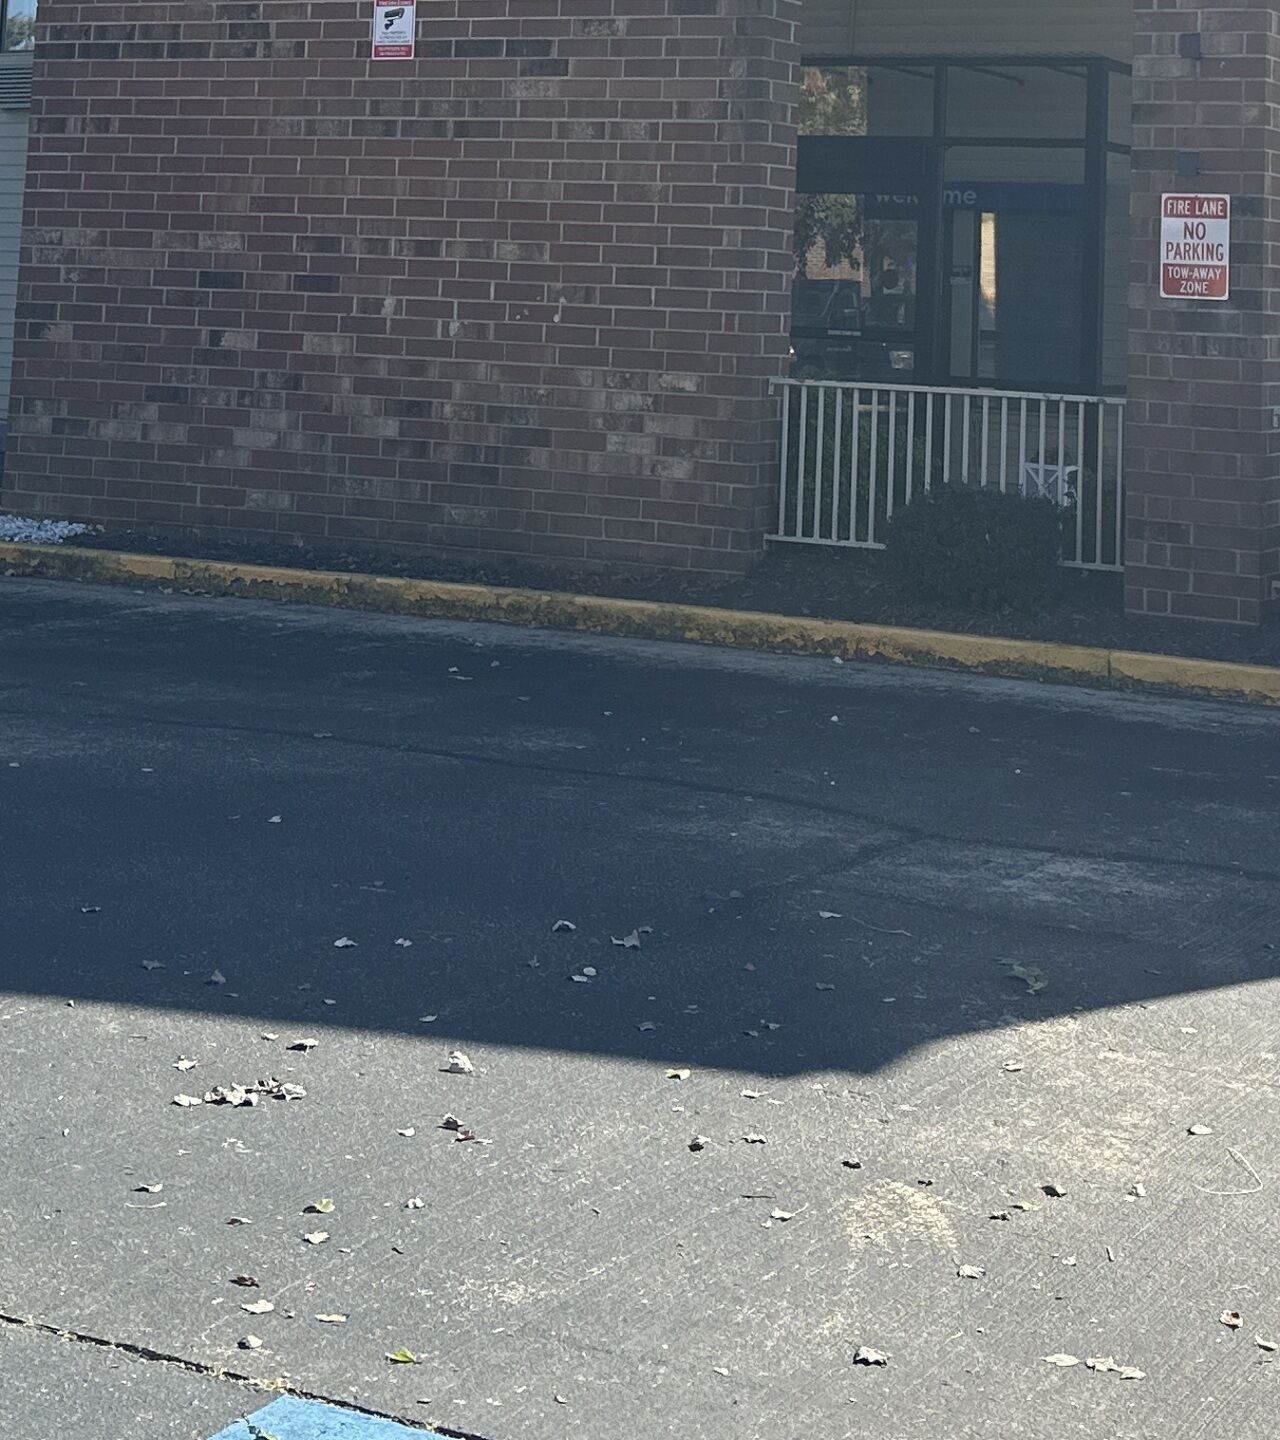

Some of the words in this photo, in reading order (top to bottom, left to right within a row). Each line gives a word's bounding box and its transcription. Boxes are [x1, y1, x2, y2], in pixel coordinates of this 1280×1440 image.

[1167, 200, 1191, 215] FIRE
[1195, 200, 1224, 216] LANE
[1183, 221, 1207, 240] NO
[1165, 241, 1224, 262] PARKING
[1167, 266, 1221, 280] TOW-AWAY
[1179, 281, 1209, 294] ZONE
